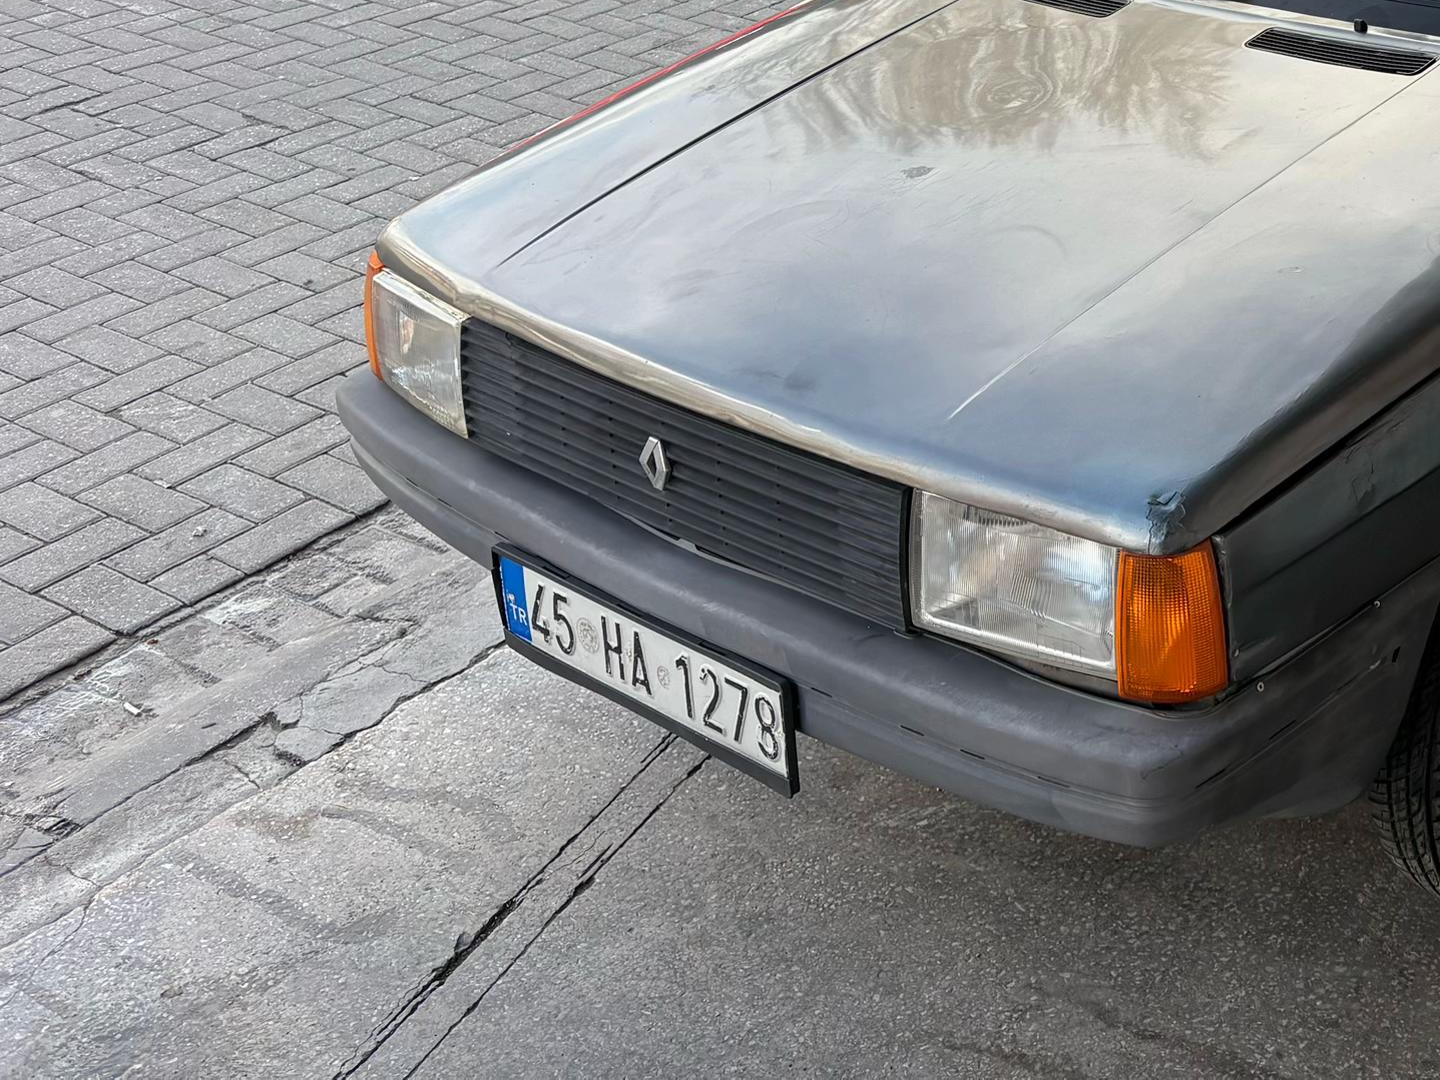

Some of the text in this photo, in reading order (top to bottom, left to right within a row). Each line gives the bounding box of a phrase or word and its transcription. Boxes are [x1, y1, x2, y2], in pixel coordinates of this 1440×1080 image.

[510, 584, 780, 760] TR 45 HA 1278
